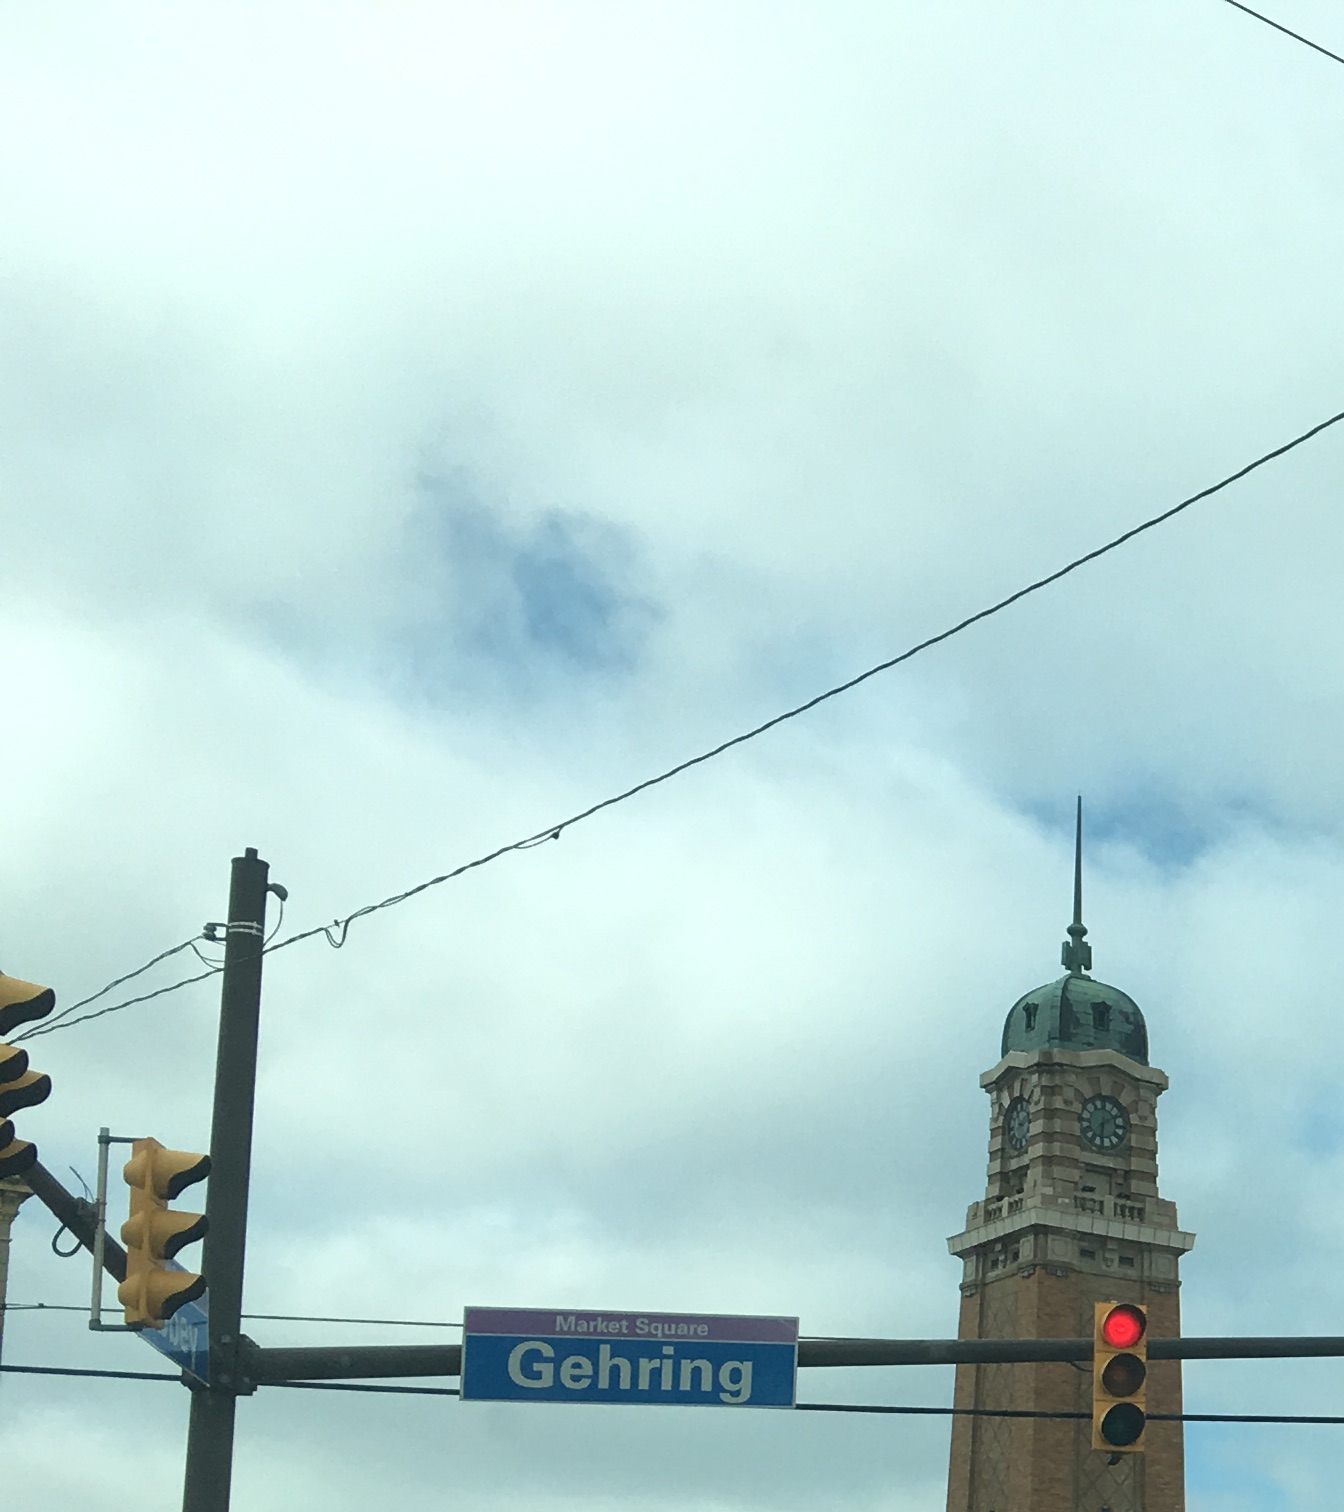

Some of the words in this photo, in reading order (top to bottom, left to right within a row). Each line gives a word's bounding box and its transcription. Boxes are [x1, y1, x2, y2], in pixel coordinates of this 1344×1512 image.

[555, 1314, 629, 1335] Market
[634, 1317, 709, 1338] Square
[507, 1340, 753, 1404] Gehring
